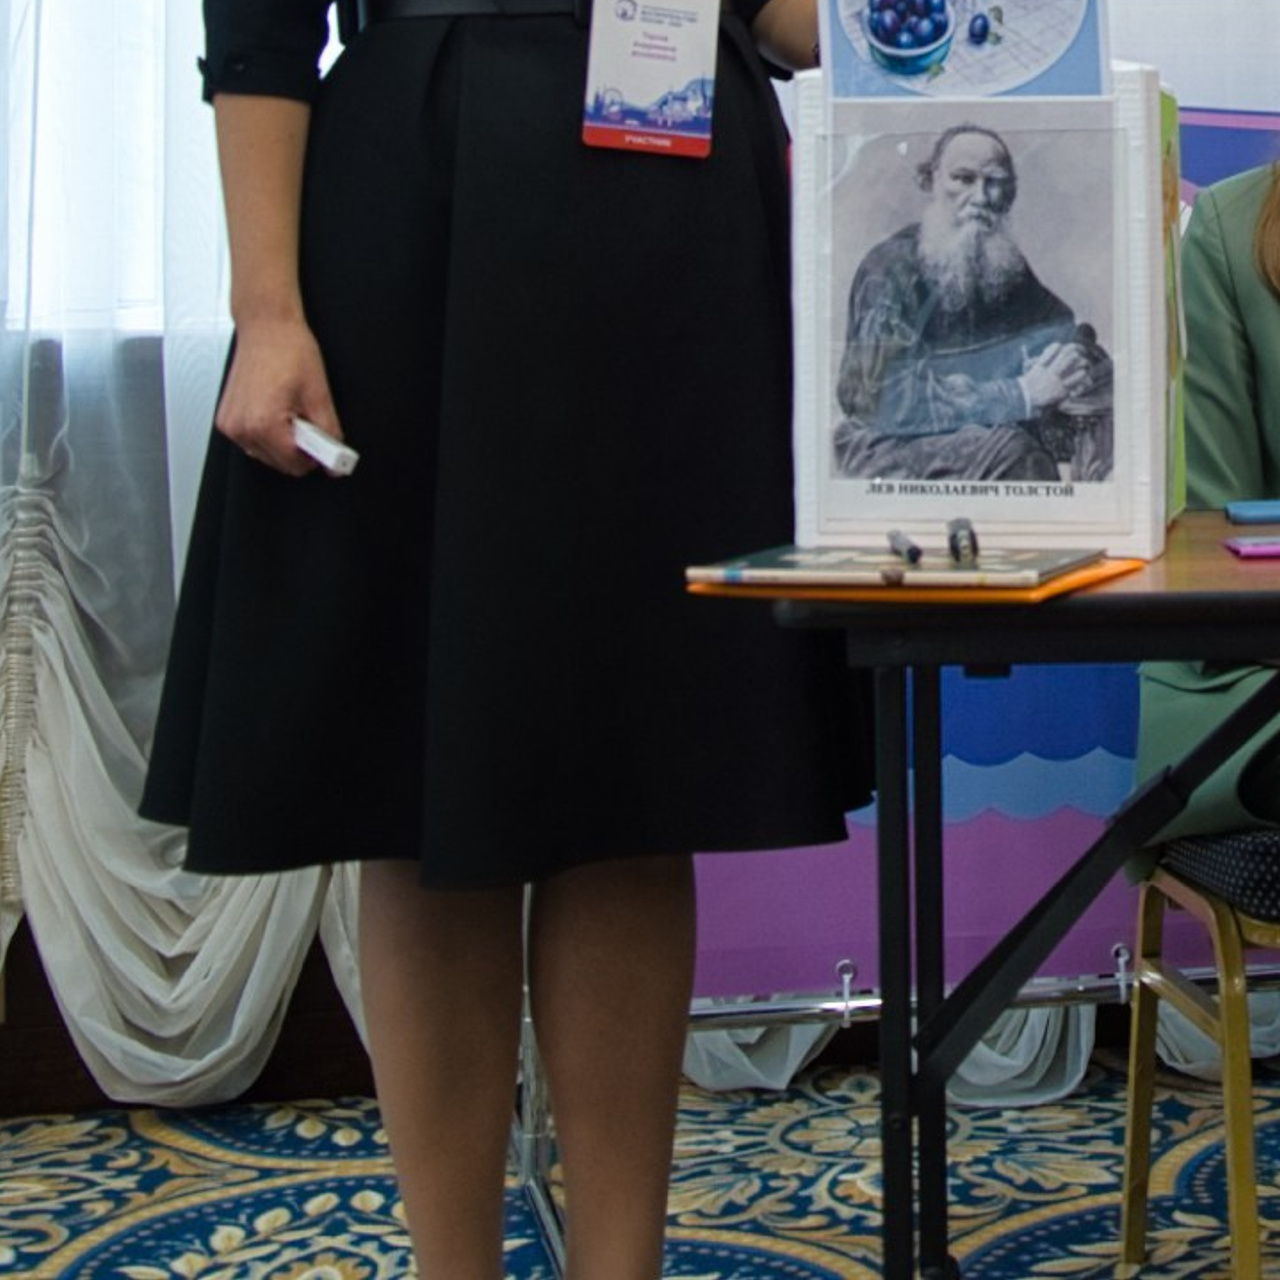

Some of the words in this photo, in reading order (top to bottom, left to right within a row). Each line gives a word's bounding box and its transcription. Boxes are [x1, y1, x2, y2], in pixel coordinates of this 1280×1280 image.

[866, 483, 895, 495] ЛЕВ
[899, 483, 999, 497] НИКОЛАЕВИЧ
[1004, 483, 1075, 497] ТОЛСТОЙ
